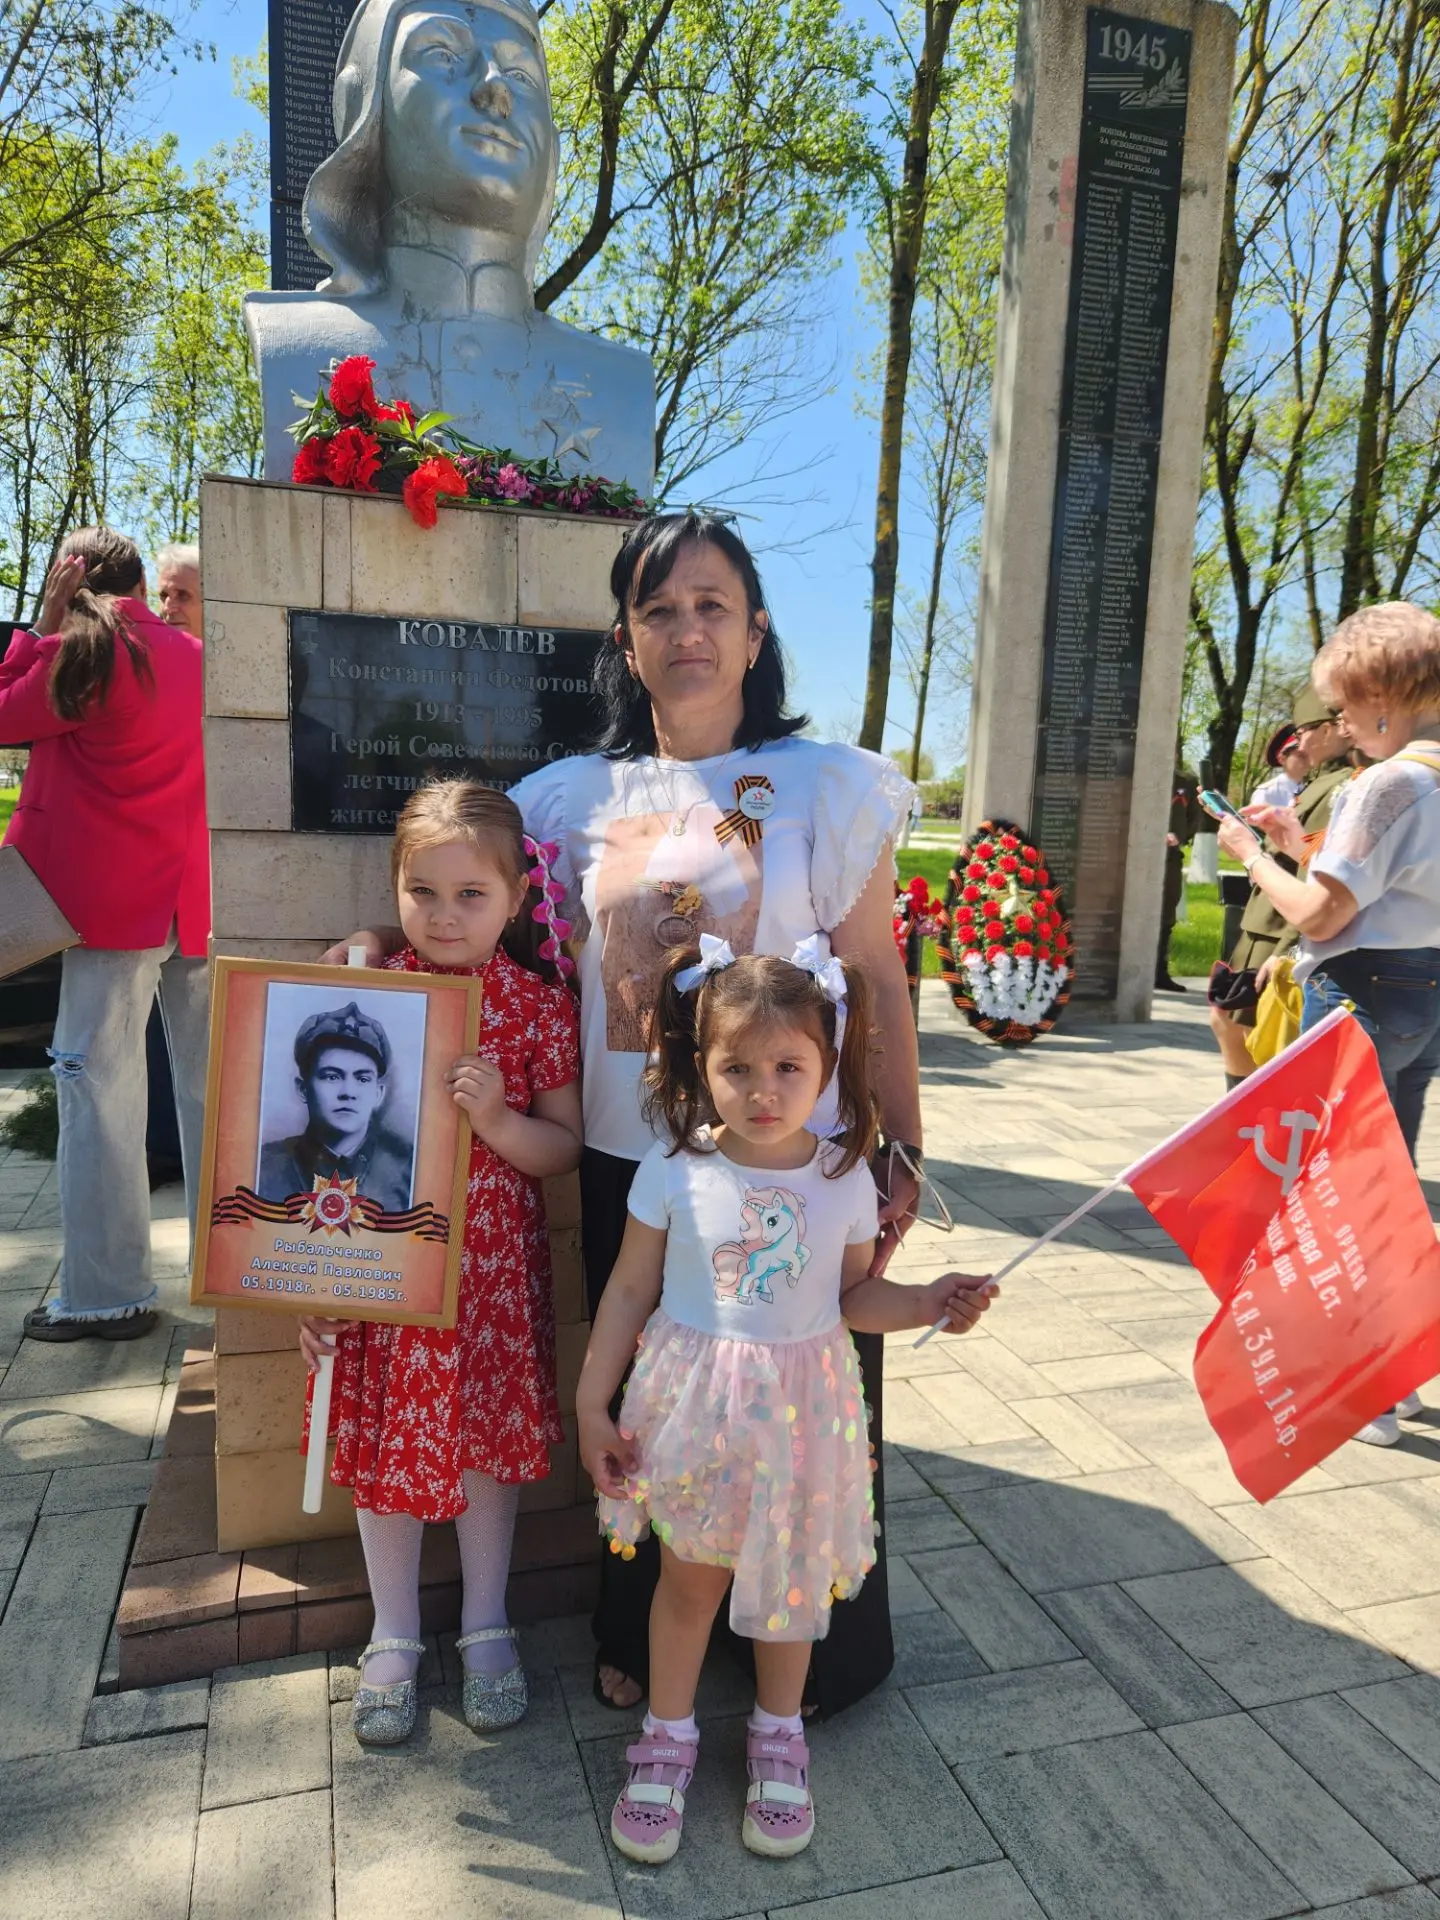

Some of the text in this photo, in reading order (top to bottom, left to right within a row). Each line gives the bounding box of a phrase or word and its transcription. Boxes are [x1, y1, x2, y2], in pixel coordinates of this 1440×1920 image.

[1098, 24, 1167, 71] 1945
[399, 620, 556, 655] КОВАЛЕВ
[328, 657, 604, 694] Константин Федотови
[413, 700, 466, 723] 1913
[331, 730, 400, 759] Герой
[409, 735, 540, 761] Советского
[274, 1238, 383, 1261] Рыбальченко
[251, 1256, 402, 1281] Алексей Павлович
[241, 1275, 316, 1294] 05.1918г.
[333, 1283, 408, 1302] 05.1985г.
[1264, 1386, 1294, 1411] 1
